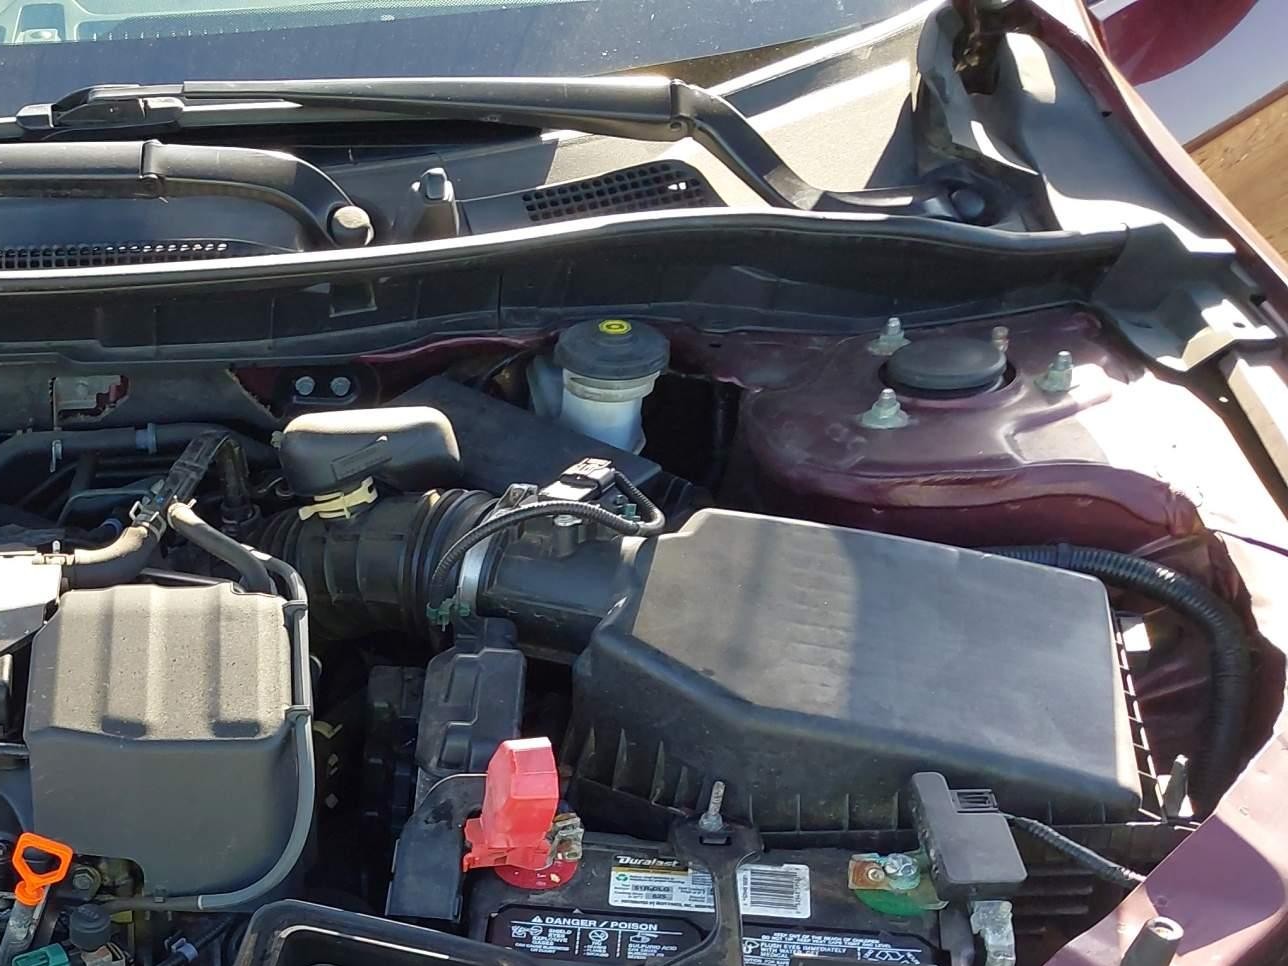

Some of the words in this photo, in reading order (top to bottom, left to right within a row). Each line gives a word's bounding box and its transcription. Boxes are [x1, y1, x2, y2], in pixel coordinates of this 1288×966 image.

[616, 855, 680, 867] Duralast
[545, 916, 597, 927] DANGER
[610, 921, 658, 931] POISON
